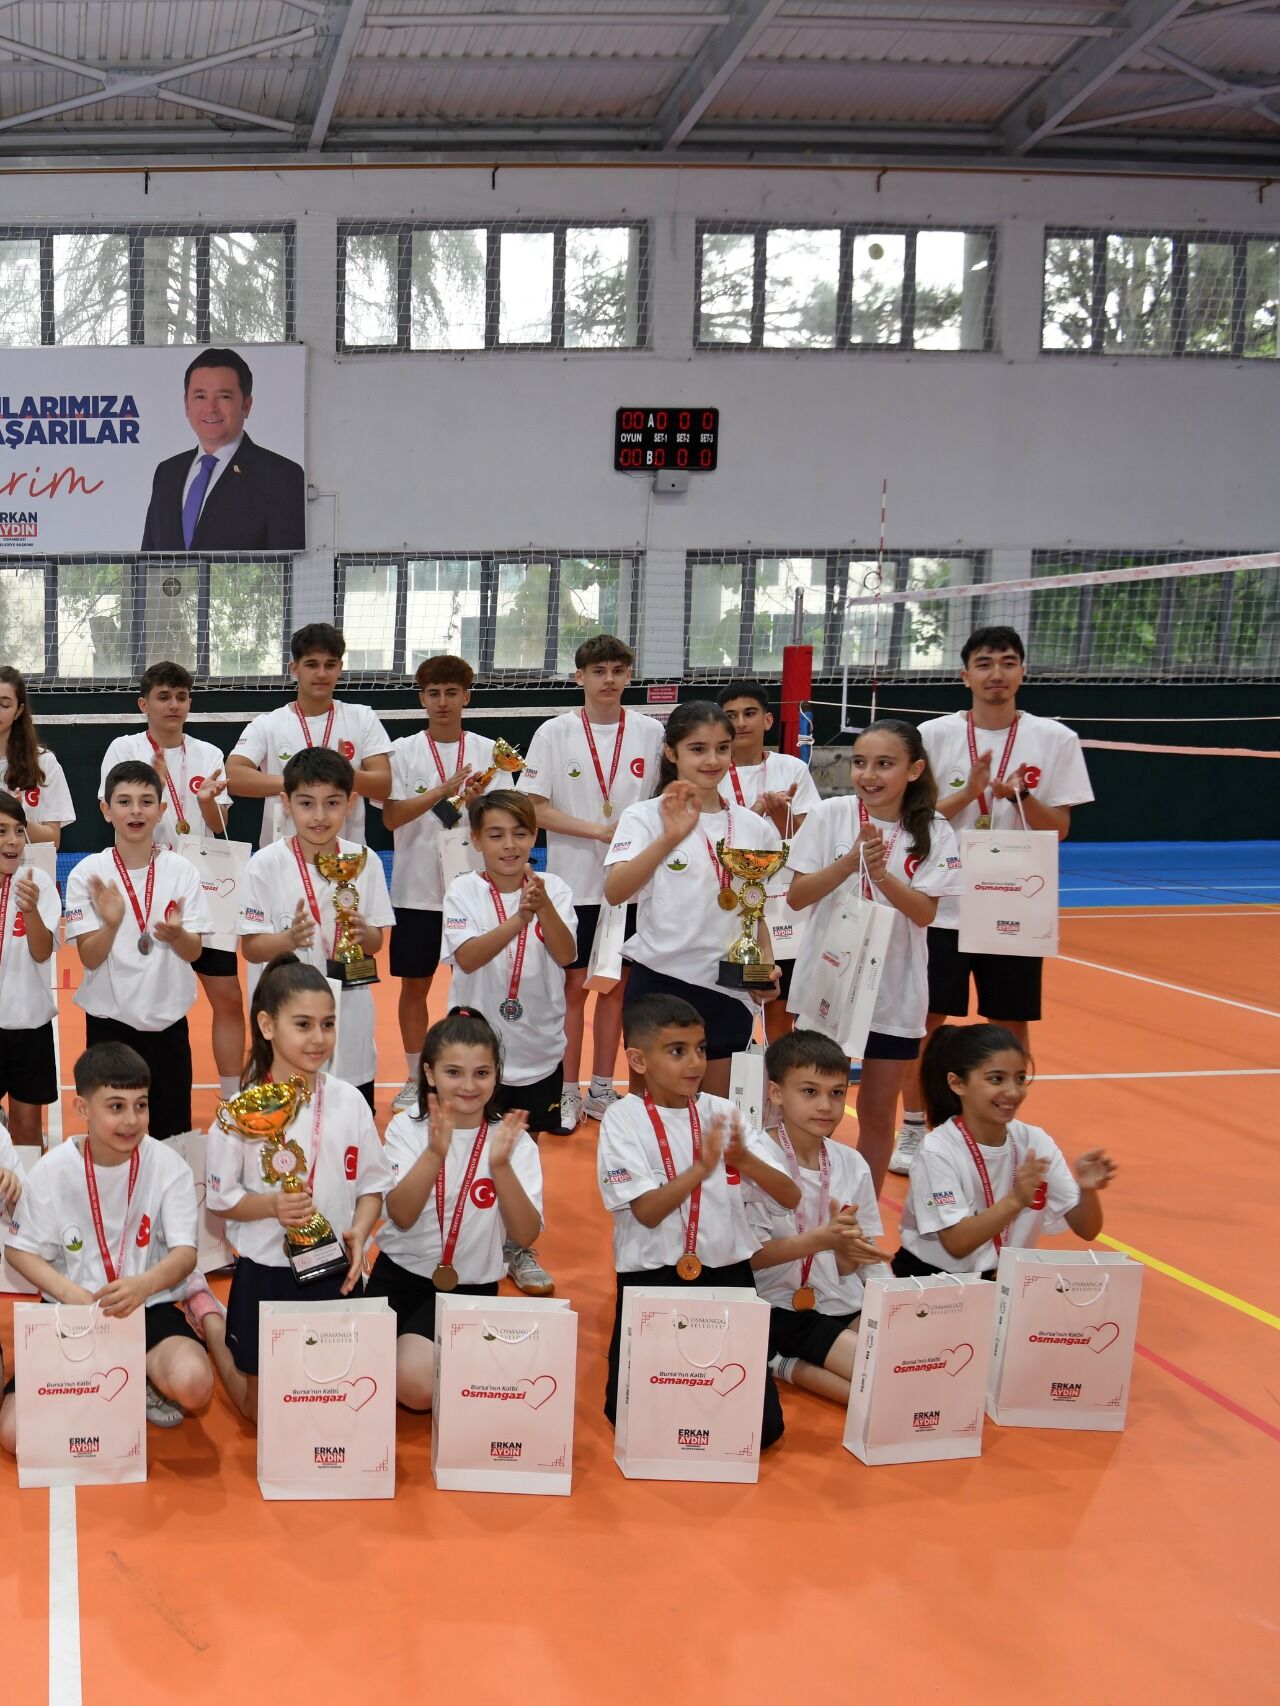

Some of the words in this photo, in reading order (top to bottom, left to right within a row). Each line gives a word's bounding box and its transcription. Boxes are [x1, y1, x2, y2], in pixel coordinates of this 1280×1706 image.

[648, 413, 654, 427] A
[621, 433, 642, 442] OYUN
[654, 434, 667, 442] SET-1
[677, 434, 690, 442] SET-2
[700, 434, 713, 442] SET-3
[647, 451, 653, 464] B
[935, 1197, 955, 1206] YDIN
[690, 1317, 728, 1325] OSMANGAZ
[1029, 1335, 1091, 1345] Osmangazi
[893, 1361, 947, 1373] Osmangazi
[650, 1376, 714, 1387] Osmangazi
[1051, 1382, 1082, 1390] ERKAN
[38, 1385, 100, 1396] Osmangazi
[461, 1389, 526, 1400] Osmangazi
[1052, 1389, 1079, 1397] AYDIN
[283, 1393, 347, 1404] Osmangazi
[914, 1411, 940, 1419] ERKAN
[914, 1418, 938, 1427] AYDIN
[491, 1441, 522, 1449] ERKAN
[315, 1455, 344, 1463] AYDIN
